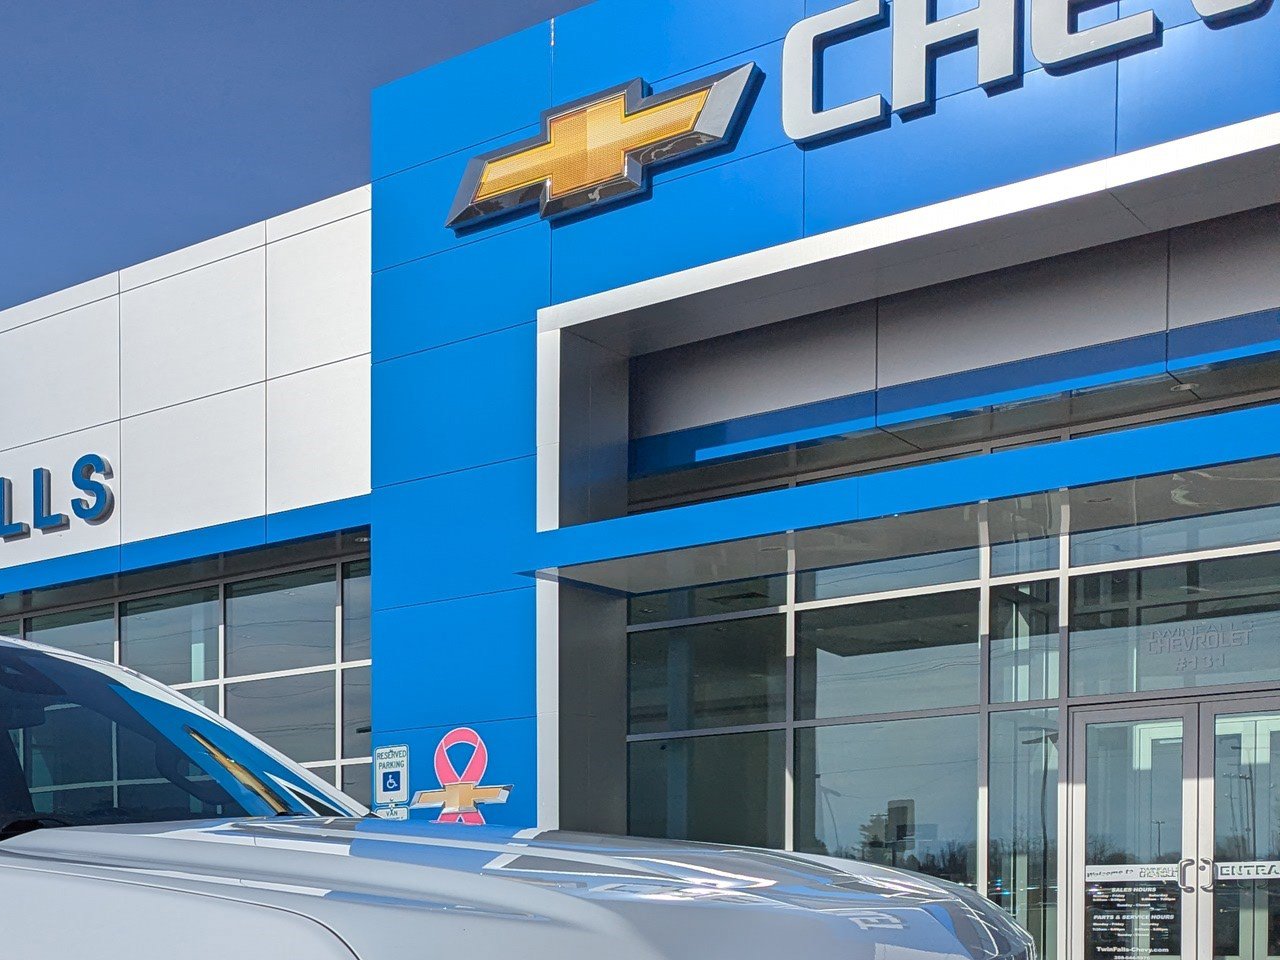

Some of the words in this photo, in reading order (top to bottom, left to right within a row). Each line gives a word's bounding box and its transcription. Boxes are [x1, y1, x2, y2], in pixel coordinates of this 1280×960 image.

[1148, 629, 1252, 655] CHEVROLET
[377, 750, 407, 760] RESERVED
[378, 760, 405, 770] PARKING
